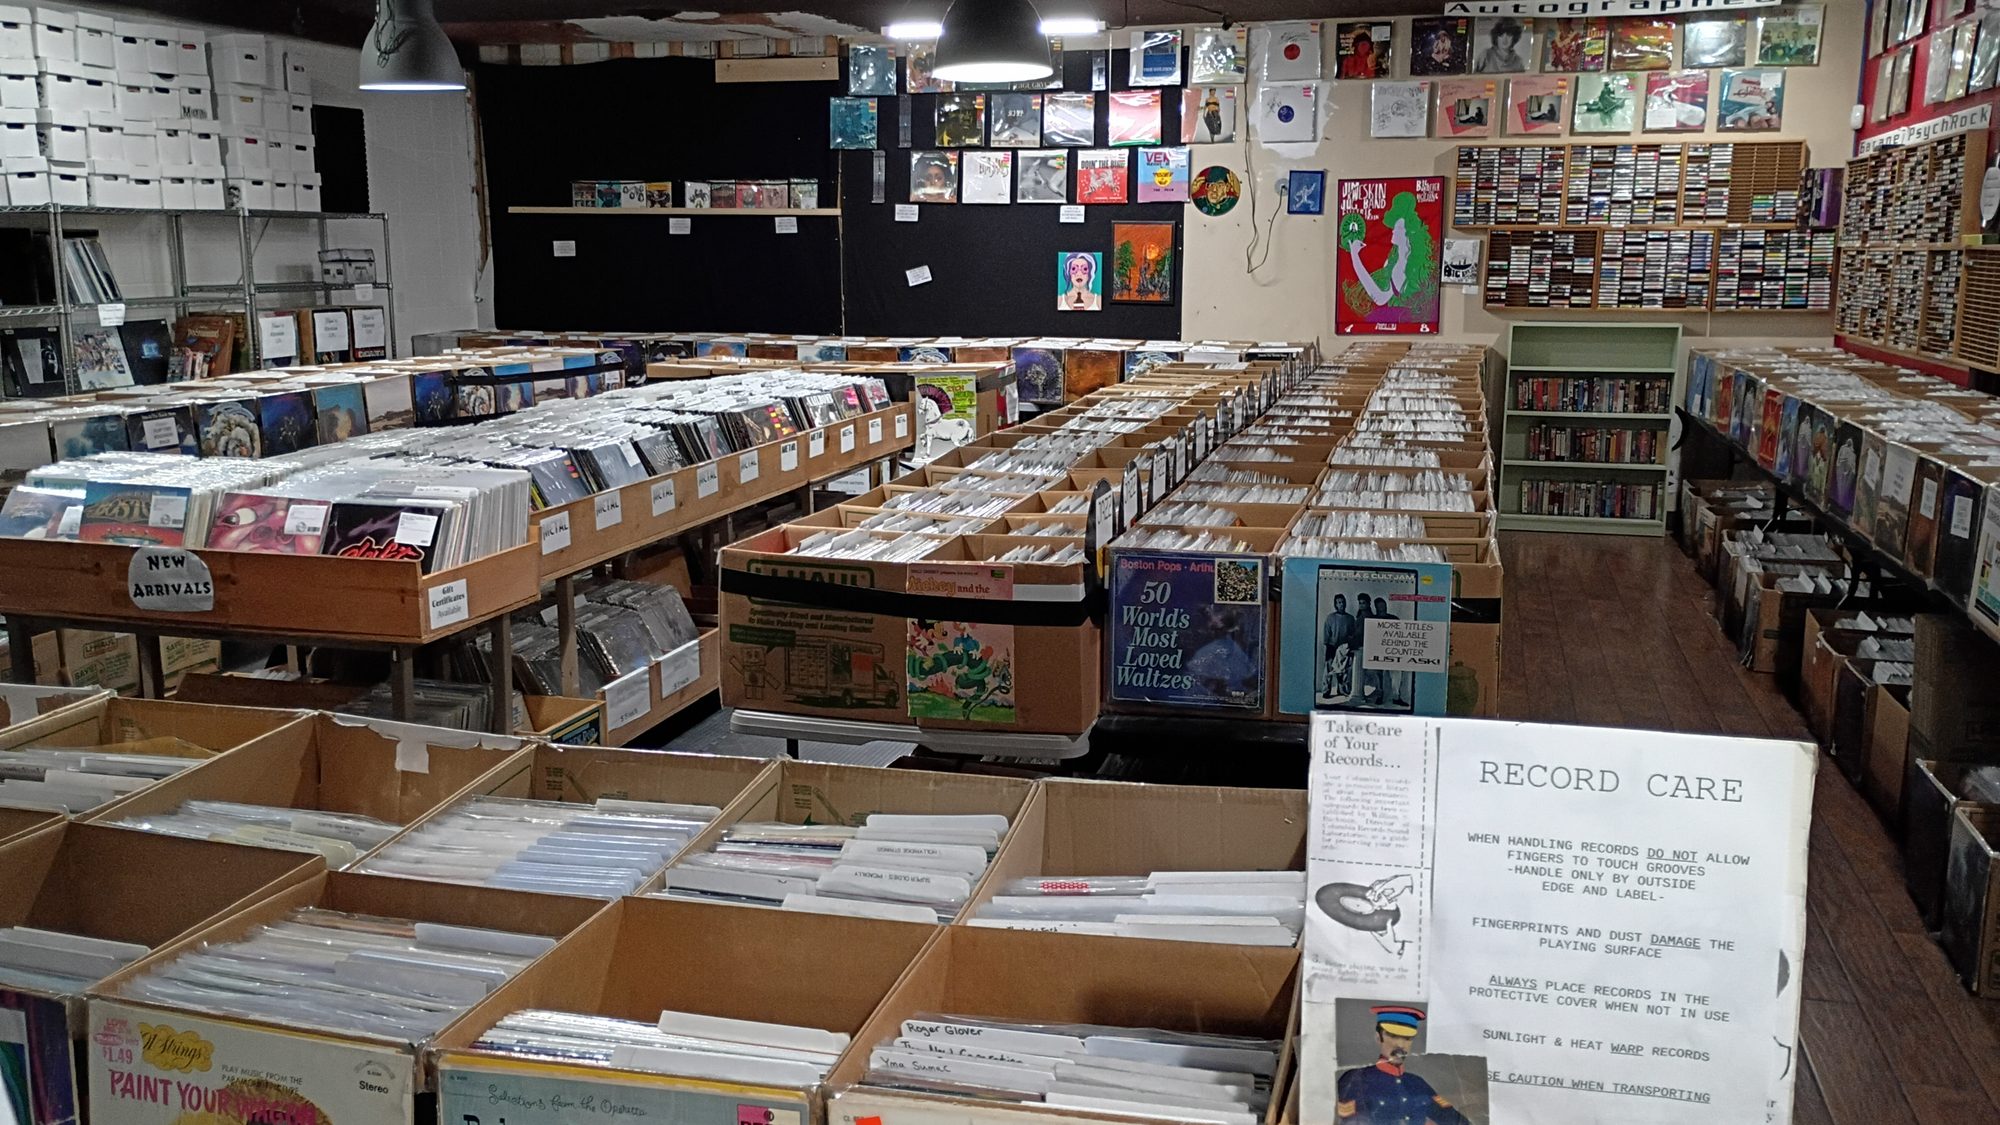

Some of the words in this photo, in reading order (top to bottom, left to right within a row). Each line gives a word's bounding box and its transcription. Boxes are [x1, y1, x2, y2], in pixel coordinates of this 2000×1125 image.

[147, 555, 186, 571] NEW
[1120, 559, 1154, 570] Boston
[1157, 560, 1182, 572] Pops
[133, 581, 211, 598] ARRIVALS
[957, 584, 973, 593] and
[975, 584, 990, 594] the
[1141, 581, 1171, 604] 50
[432, 593, 465, 608] Certificates
[1122, 605, 1190, 629] World's
[1377, 621, 1402, 630] MORE
[1404, 622, 1434, 631] TITLES
[1130, 627, 1178, 648] Most
[1381, 639, 1411, 648] BEHIND
[1414, 640, 1429, 649] THE
[1382, 630, 1427, 639] AVAILABLE
[1123, 646, 1183, 669] Loved
[1367, 655, 1404, 663] JUST
[1406, 657, 1441, 665] ASK!
[1385, 647, 1424, 656] COUNTER
[1117, 665, 1194, 689] Waltzes
[1325, 719, 1363, 734] Take
[1365, 721, 1402, 737] Care
[1324, 736, 1339, 749] of
[1344, 736, 1379, 751] Your
[1324, 750, 1401, 768] Records...
[1479, 760, 1620, 793] RECORD
[1647, 773, 1744, 803] CARE
[1467, 832, 1500, 845] WHEN
[1508, 836, 1573, 851] HANDLING
[1580, 841, 1639, 856] RECORDS
[1646, 848, 1665, 859] DO
[1671, 850, 1698, 863] NOT
[1706, 853, 1751, 866] ALLOW
[1507, 850, 1564, 864] FINGERS
[1572, 855, 1589, 866] TO
[1597, 857, 1639, 871] TOUCH
[1646, 862, 1706, 877] GROOVES
[1542, 881, 1575, 894] EDGE
[1582, 885, 1608, 897] AND
[1571, 869, 1604, 882] ONLY
[1612, 872, 1629, 885] BY
[1637, 875, 1696, 891] OUTSIDE
[1472, 916, 1569, 936] FINGERPRINTS
[1576, 927, 1601, 939] AND
[1609, 929, 1642, 943] DUST
[1650, 933, 1701, 949] DAMAGE
[1709, 938, 1735, 951] THE
[1539, 937, 1597, 953] PLAYING
[1604, 944, 1662, 959] SURFACE
[1488, 974, 1537, 990] ALWAYS
[1545, 980, 1586, 994] PLACE
[1593, 985, 1652, 1000] RECORDS
[1660, 991, 1676, 1002] IN
[1685, 993, 1710, 1006] THE
[1469, 985, 1549, 1004] PROTECTIVE
[1556, 995, 1597, 1009] COVER
[1604, 1000, 1639, 1013] WHEN
[1646, 1004, 1670, 1017] NOT
[1680, 1007, 1696, 1019] IN
[1704, 1010, 1731, 1022] USE
[906, 1022, 941, 1037] Roger
[944, 1025, 984, 1036] Glover
[159, 1035, 201, 1069] Strings
[1482, 1028, 1546, 1046] SUNLIGHT
[1554, 1036, 1563, 1047] &
[1570, 1038, 1603, 1050] HEAT
[1610, 1042, 1644, 1056] WARP
[1652, 1046, 1711, 1062] RECORDS
[880, 1056, 905, 1068] Yma
[911, 1061, 952, 1073] Sumac
[240, 1068, 264, 1078] MUSIC
[265, 1071, 288, 1082] FROM
[289, 1076, 303, 1086] THE
[108, 1068, 173, 1106] PAINT
[176, 1080, 230, 1114] YOUR
[359, 1080, 389, 1094] Stereo
[1508, 1072, 1564, 1088] CAUTION
[1571, 1079, 1605, 1092] WHEN
[1612, 1082, 1712, 1104] TRANSPORTING
[488, 1083, 546, 1111] Selections
[551, 1094, 575, 1112] from
[580, 1095, 596, 1113] the
[600, 1098, 649, 1117] Operetta
